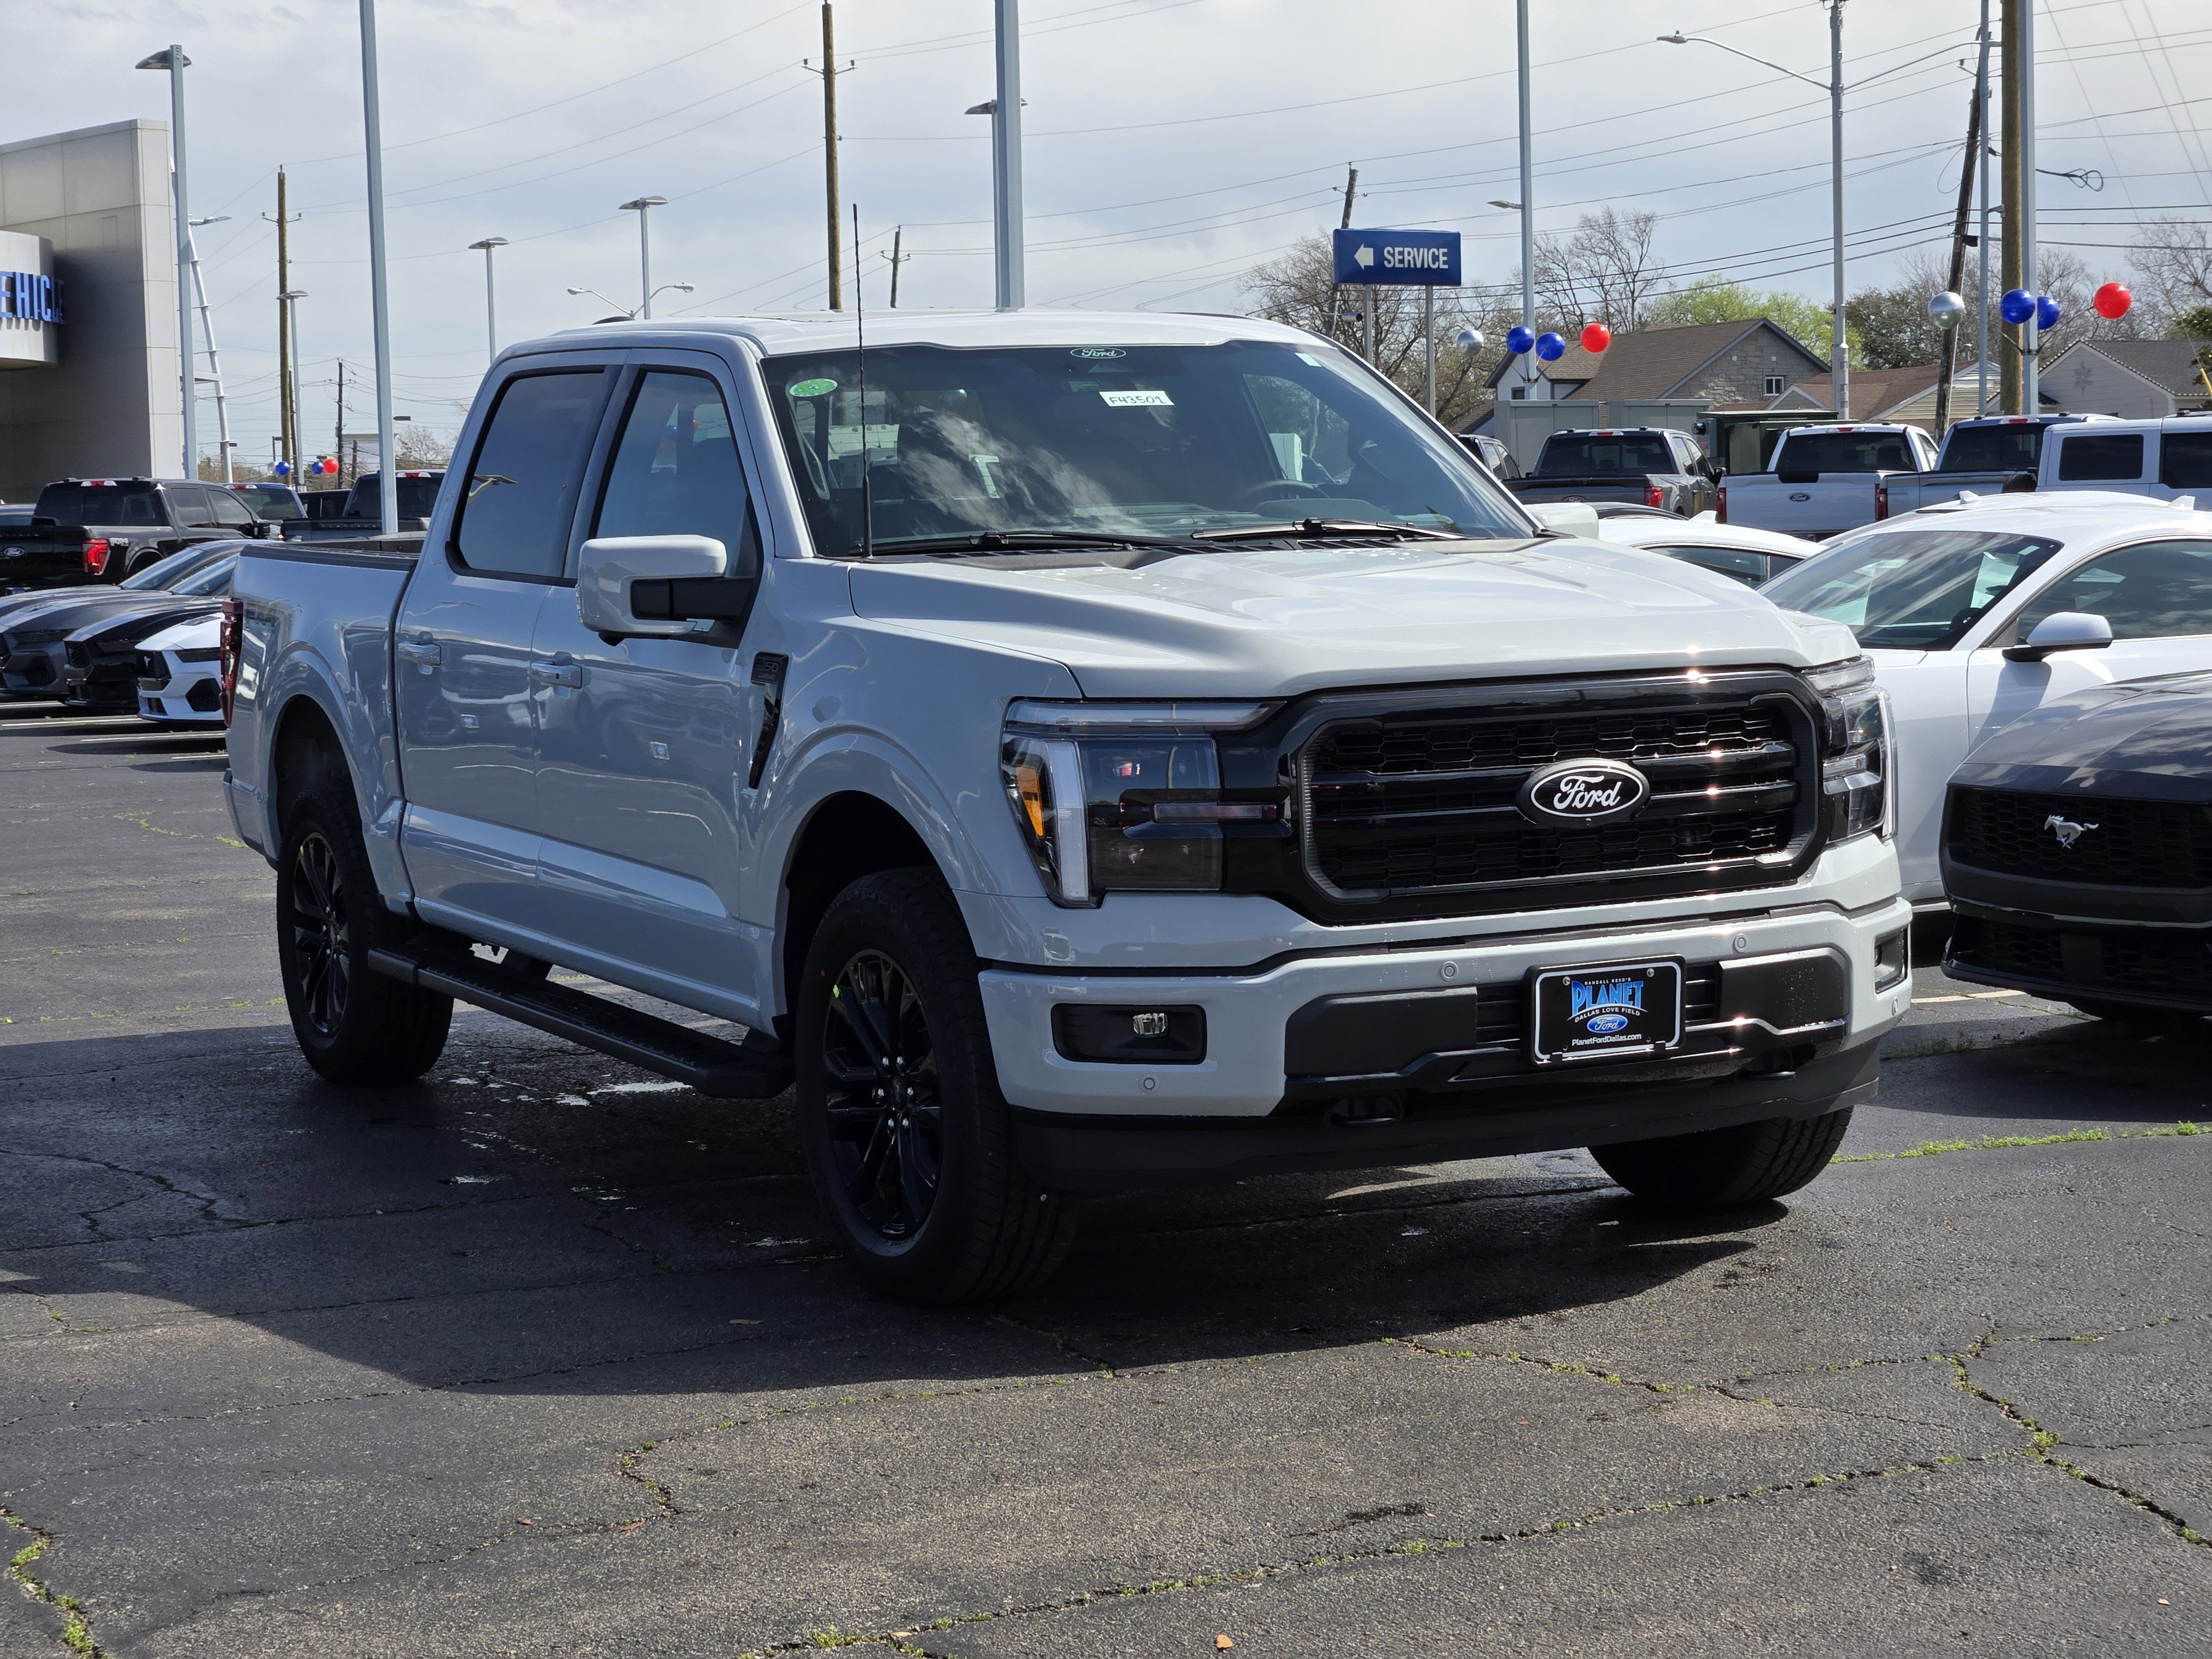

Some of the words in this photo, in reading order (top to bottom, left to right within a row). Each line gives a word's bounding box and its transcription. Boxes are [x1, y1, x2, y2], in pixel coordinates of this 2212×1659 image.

[1384, 246, 1448, 269] SERVICE
[1081, 348, 1118, 357] Ford
[1109, 395, 1166, 405] F43501
[1553, 775, 1622, 810] Ford
[1572, 980, 1644, 1016] PLANET
[1574, 1009, 1600, 1023] DALLAS
[1621, 1008, 1640, 1016] FIELD
[1594, 1018, 1620, 1030] Ford
[1572, 1034, 1642, 1046] PlanetFordDallas.com
